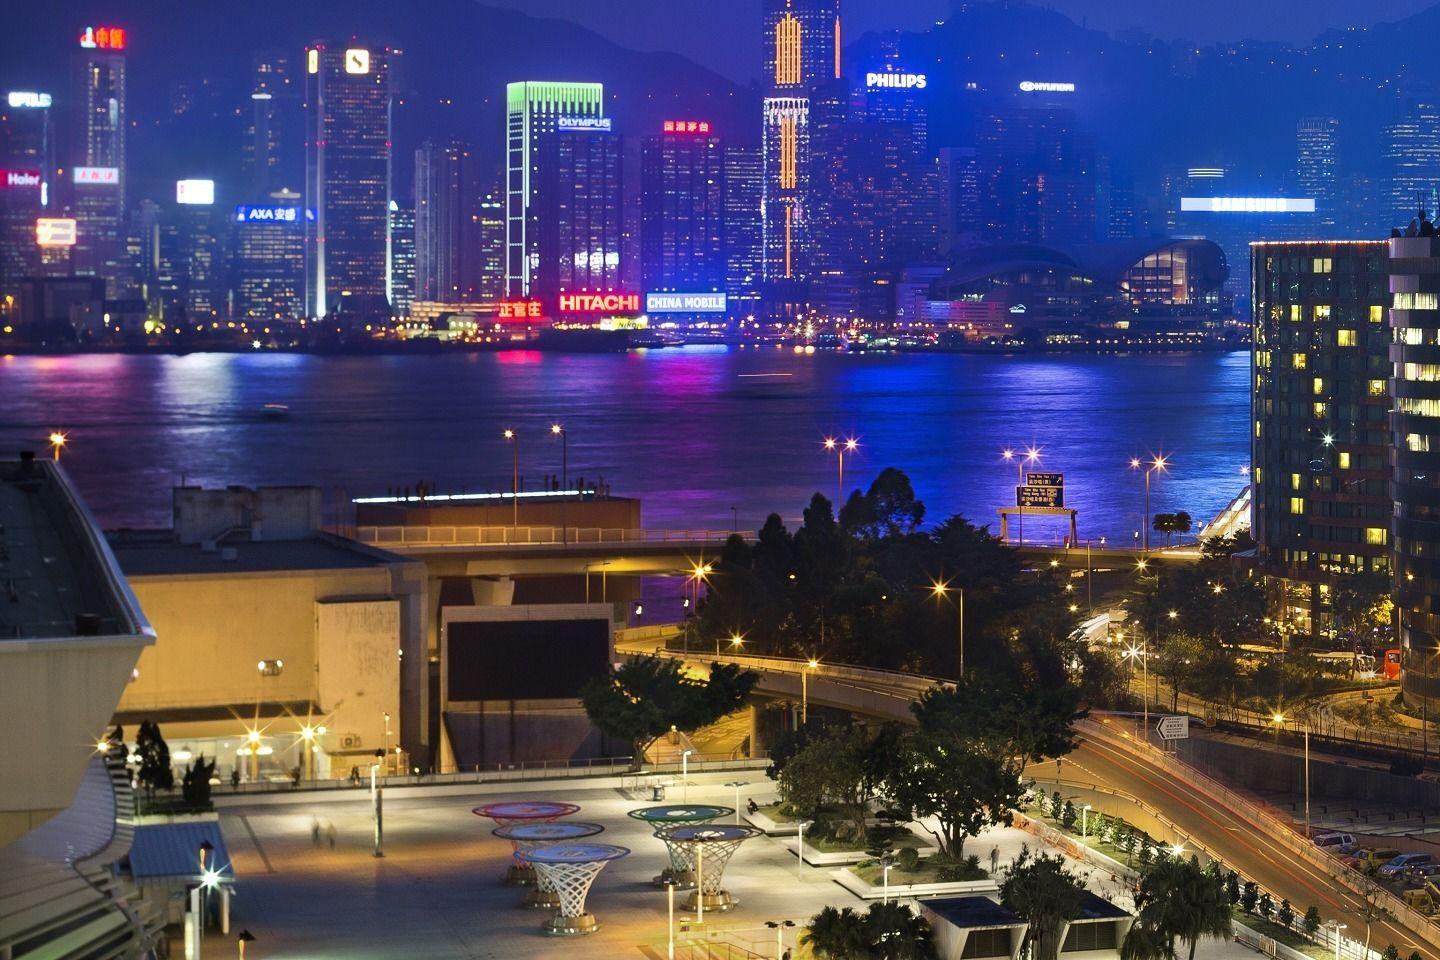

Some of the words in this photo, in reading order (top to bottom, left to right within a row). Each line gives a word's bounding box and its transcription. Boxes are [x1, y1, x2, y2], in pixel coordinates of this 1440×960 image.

[866, 72, 927, 89] PHILIPS
[558, 117, 611, 128] OLYMPUS
[7, 172, 40, 185] Haier
[249, 208, 274, 220] AXA
[499, 301, 541, 317] 正官庄
[559, 295, 639, 310] HITACHI
[648, 296, 682, 309] CHINA
[684, 296, 725, 309] MOBILE
